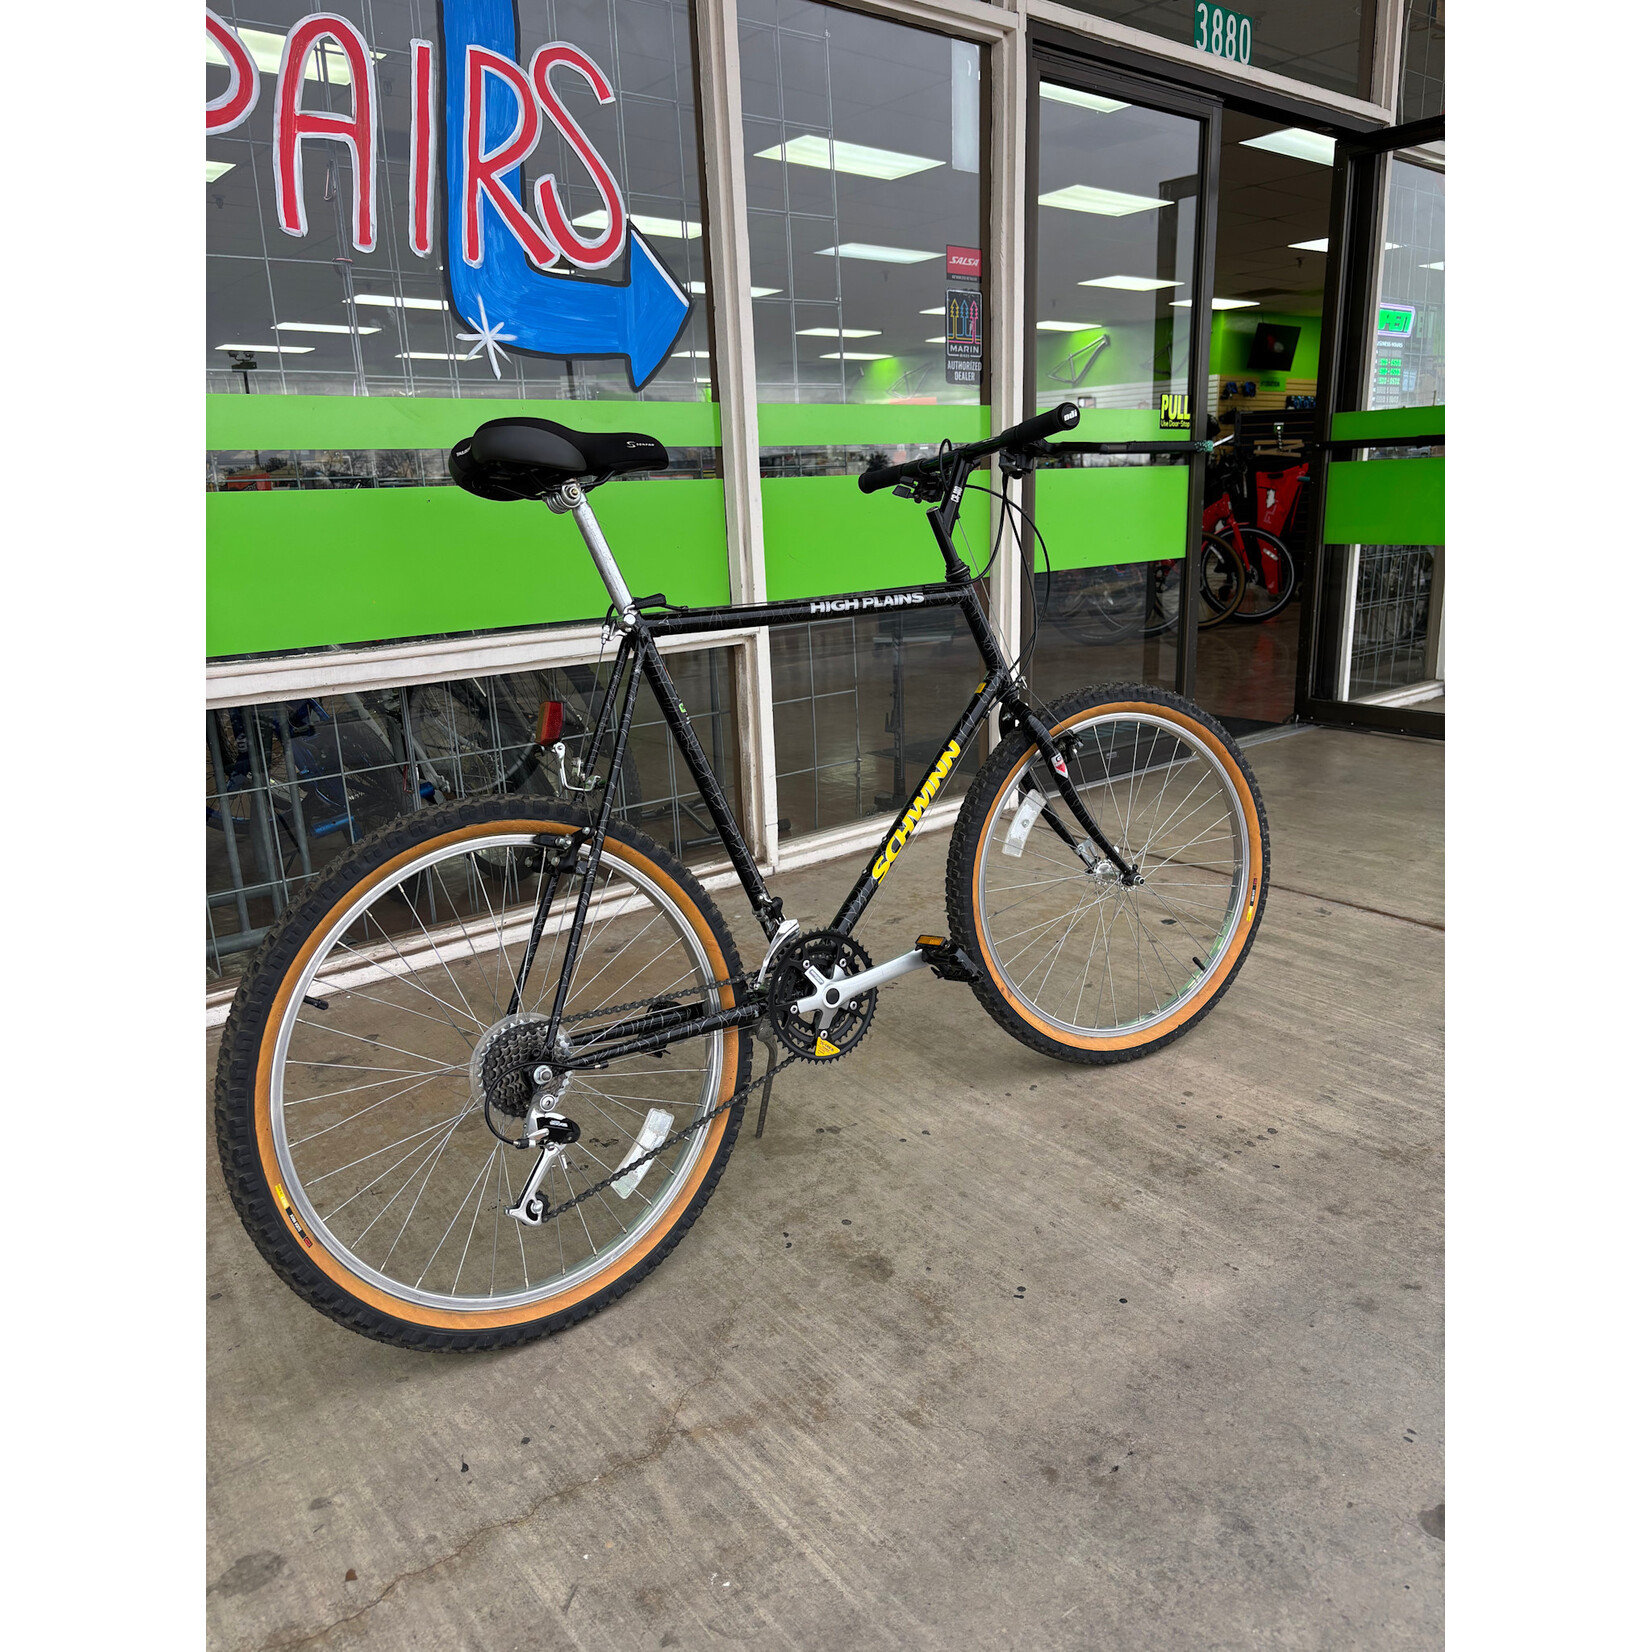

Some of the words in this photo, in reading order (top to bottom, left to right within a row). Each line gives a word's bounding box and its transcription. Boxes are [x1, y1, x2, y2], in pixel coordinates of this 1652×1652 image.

[1196, 2, 1251, 65] 3880
[949, 255, 980, 267] SALSA
[1378, 308, 1413, 333] PEN
[950, 344, 980, 354] MARIN
[947, 360, 982, 372] AUTHORIZED
[954, 370, 976, 382] DEALER
[1161, 394, 1191, 420] PULL
[810, 598, 859, 614] HIGH
[862, 592, 925, 609] PLAINS
[872, 739, 961, 885] SCHWINN
